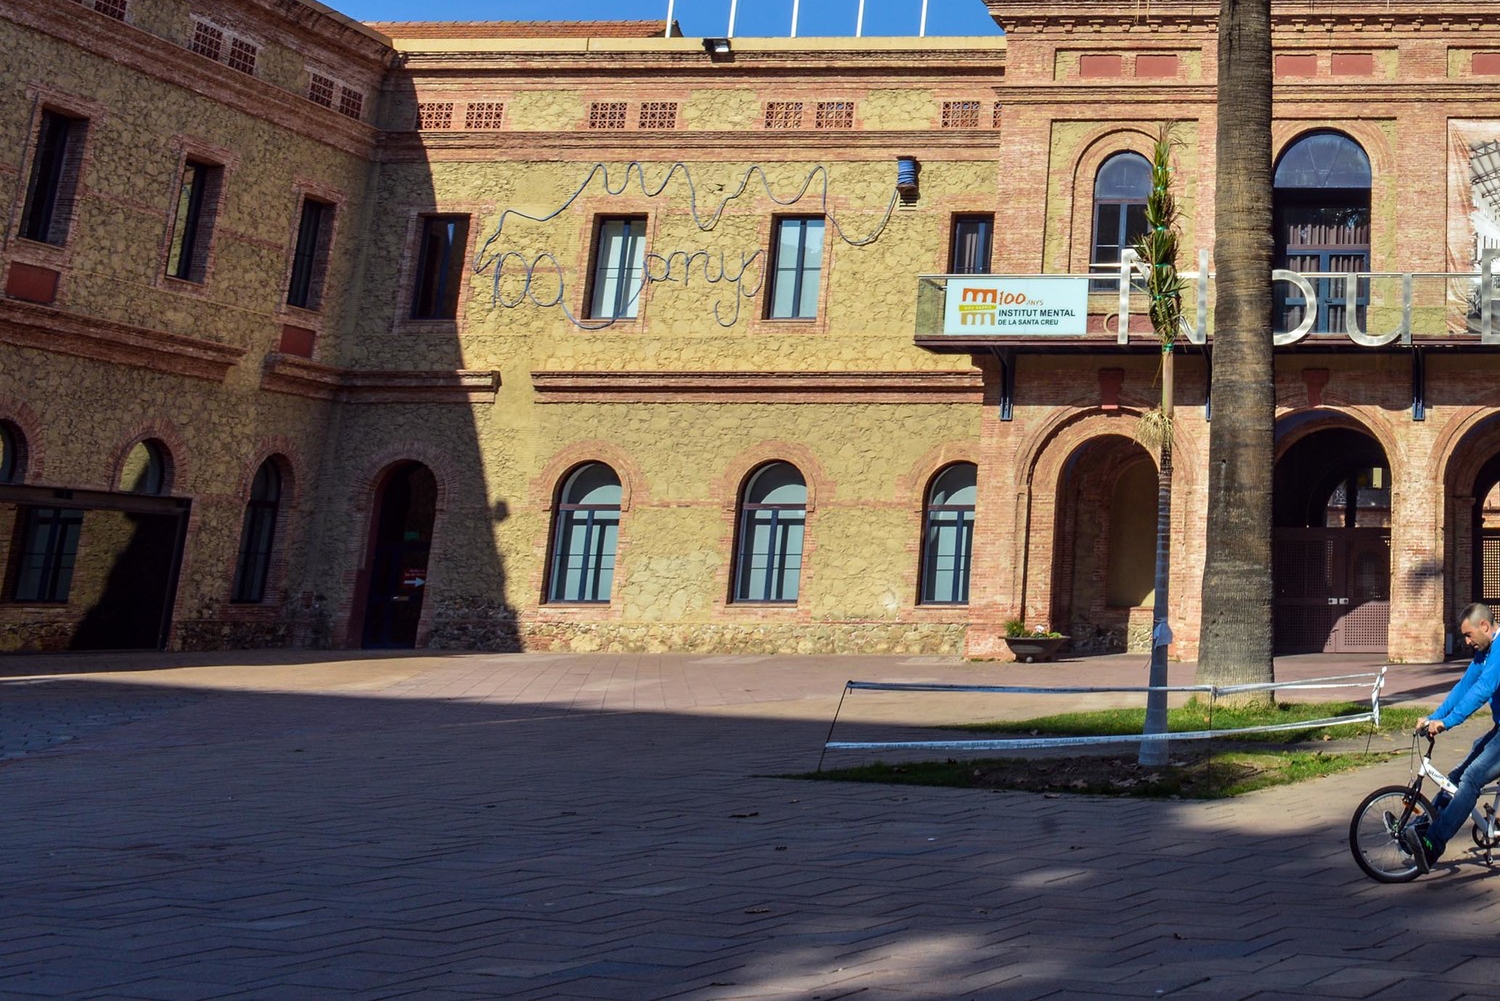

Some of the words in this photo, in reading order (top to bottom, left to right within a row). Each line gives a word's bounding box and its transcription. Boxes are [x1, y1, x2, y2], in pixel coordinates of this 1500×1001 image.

[998, 291, 1026, 305] 100
[998, 309, 1038, 317] INSTITUT
[1040, 309, 1076, 317] MENTAL
